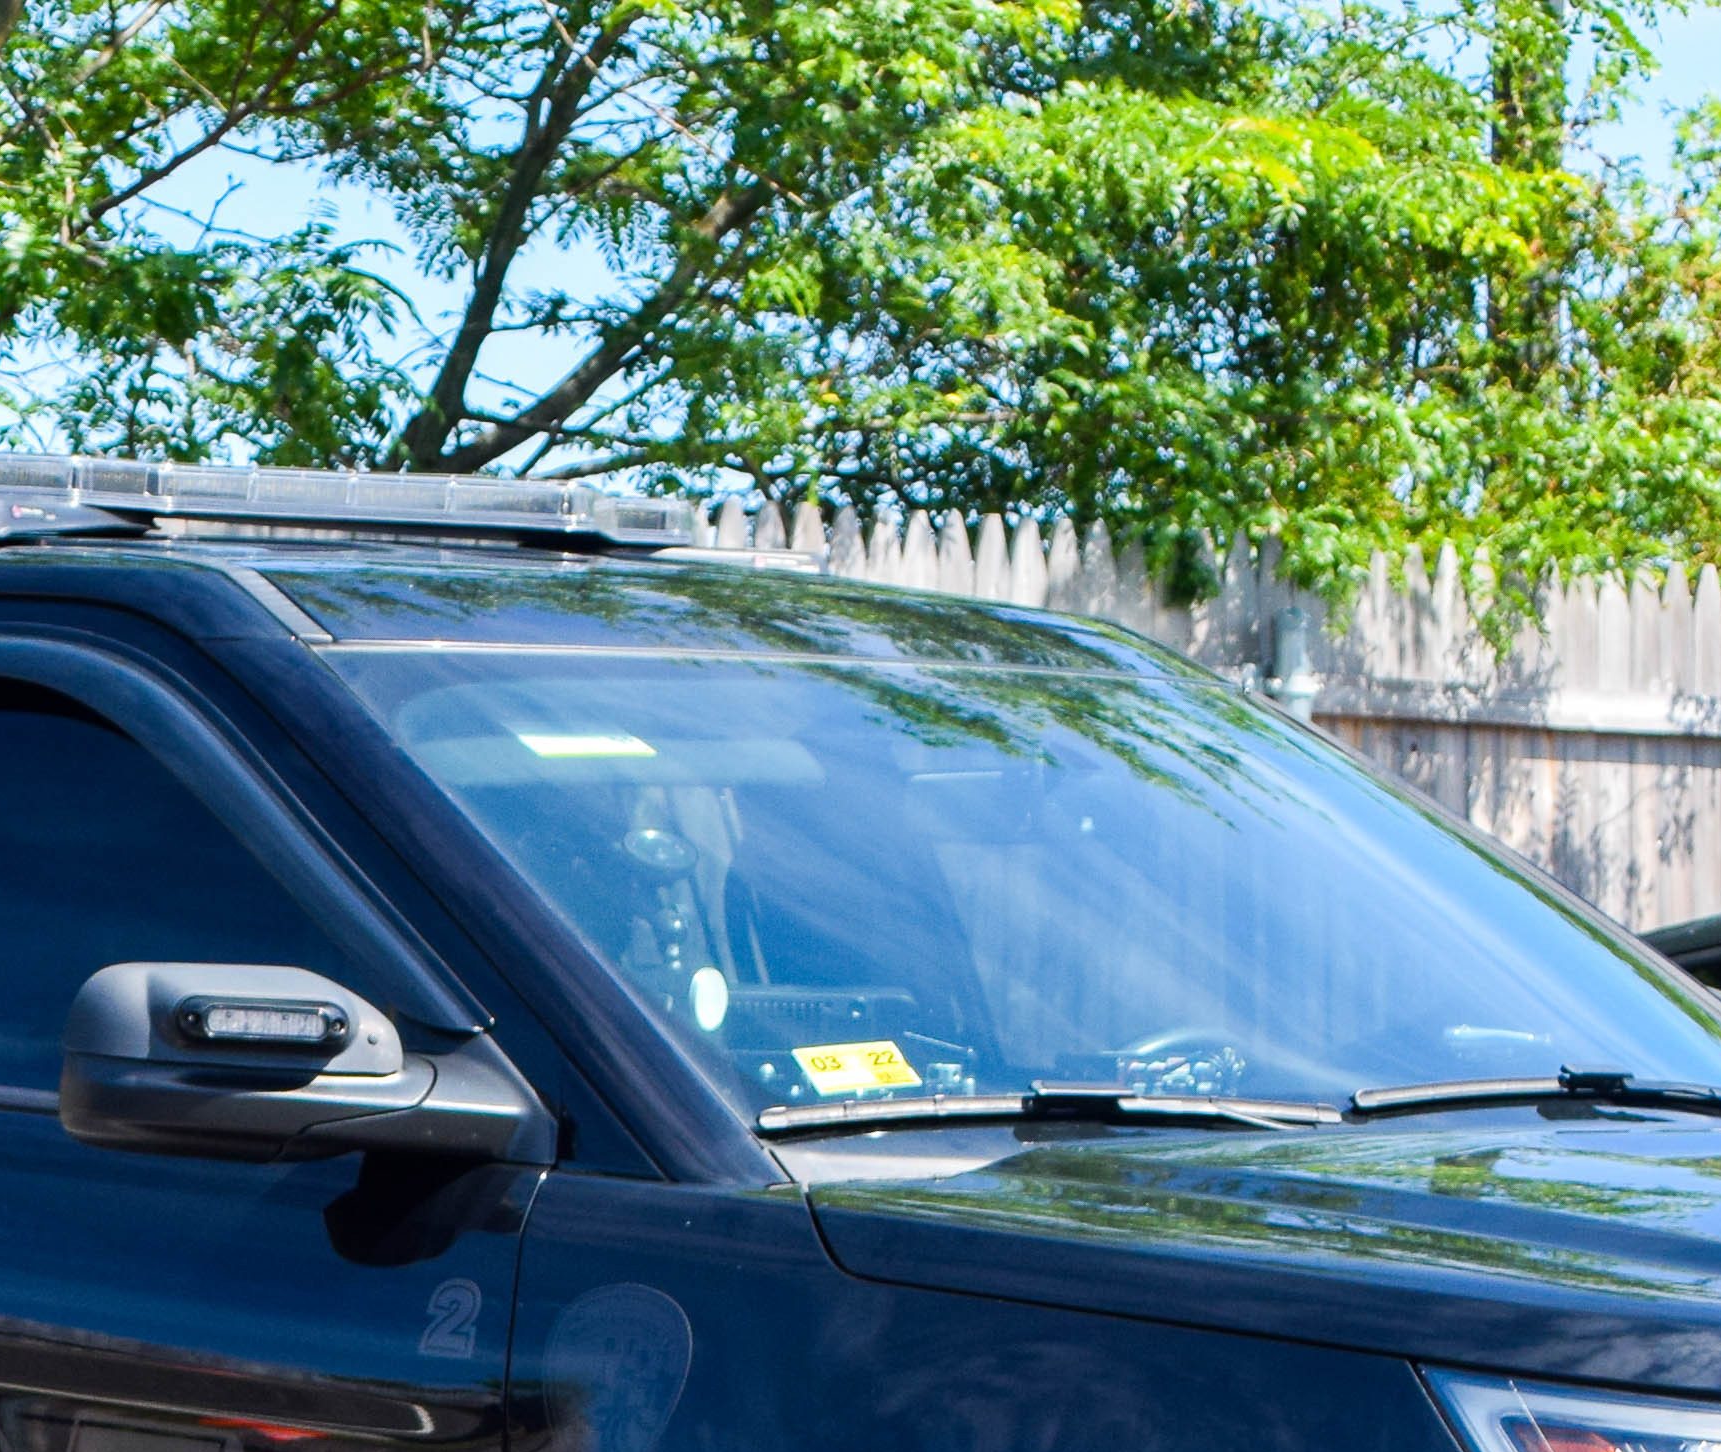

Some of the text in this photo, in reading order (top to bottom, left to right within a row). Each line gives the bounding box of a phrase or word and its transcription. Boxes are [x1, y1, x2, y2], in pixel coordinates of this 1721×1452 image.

[811, 1051, 899, 1071] 03 22
[418, 1278, 482, 1360] 2
